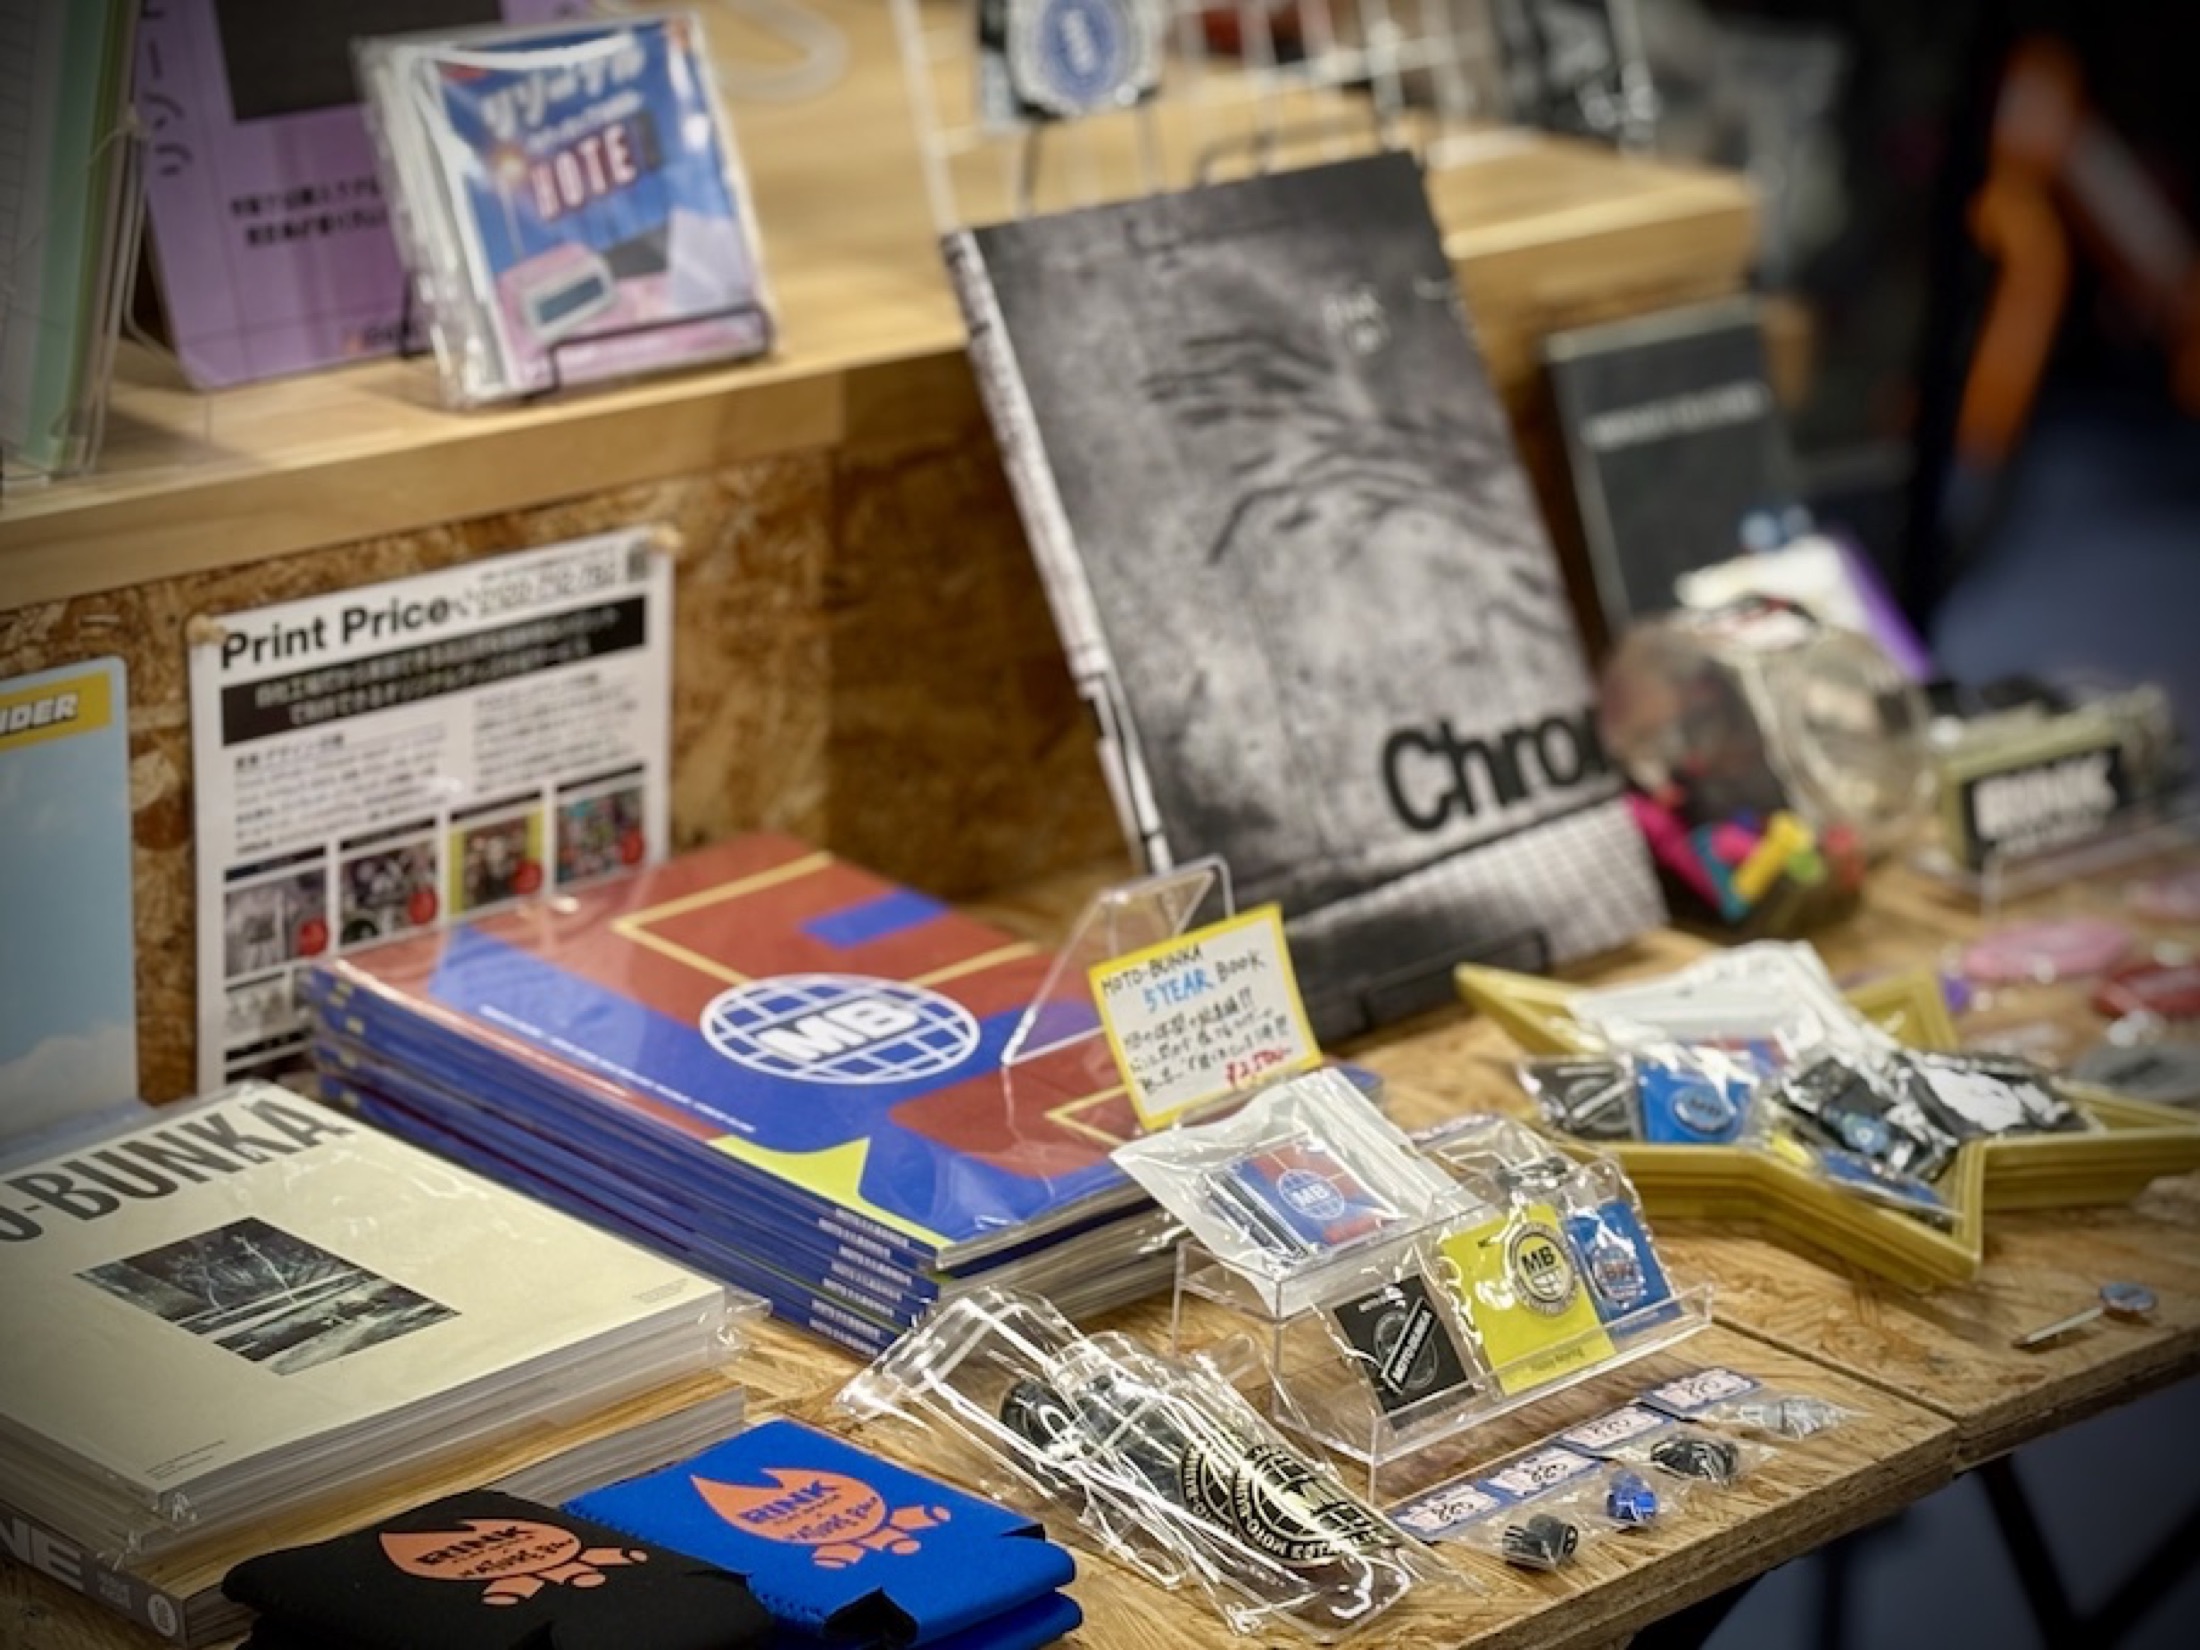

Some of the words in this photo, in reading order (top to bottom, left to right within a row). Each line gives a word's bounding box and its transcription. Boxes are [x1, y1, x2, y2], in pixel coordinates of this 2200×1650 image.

[221, 615, 327, 669] Print
[341, 597, 449, 643] Price
[1380, 704, 1609, 836] Chro
[756, 999, 920, 1062] MB
[1288, 1181, 1332, 1208] MB
[1520, 1245, 1557, 1276] MB
